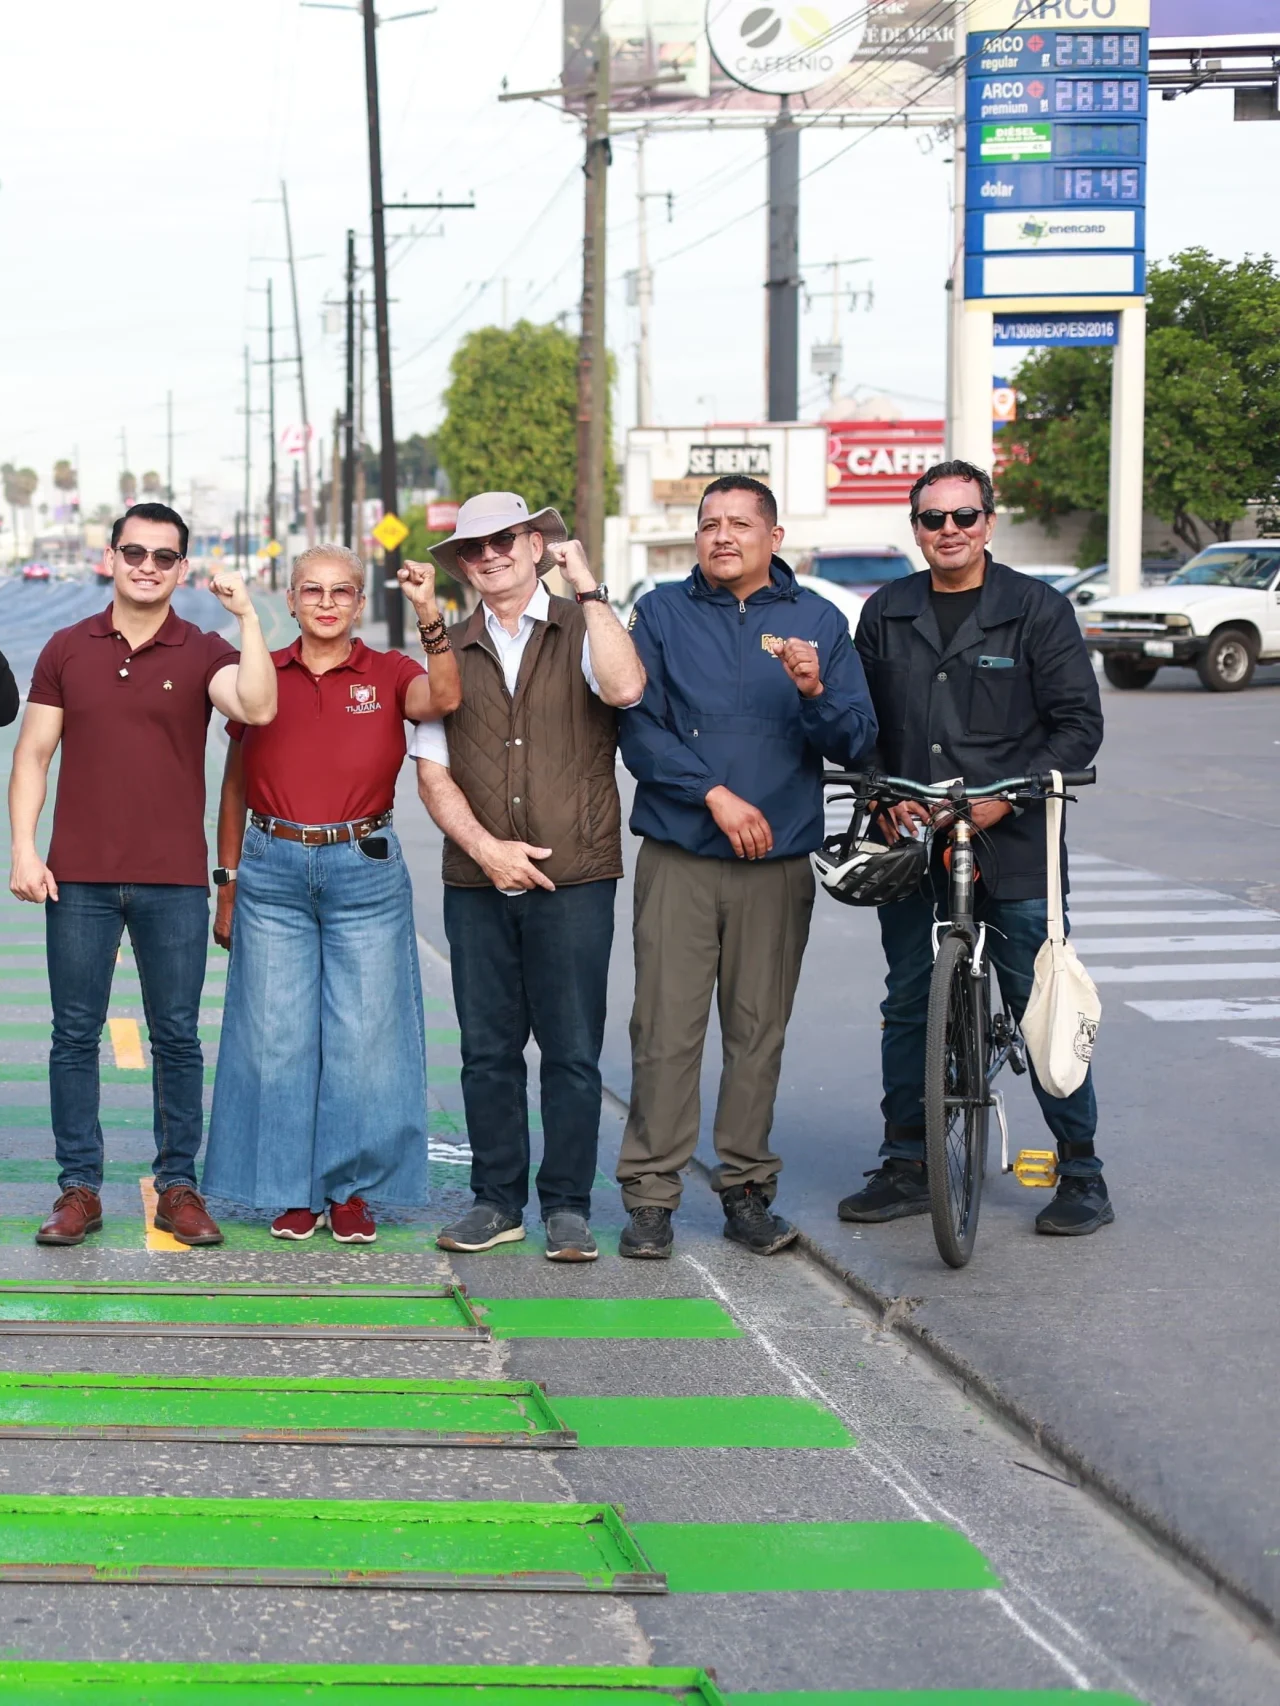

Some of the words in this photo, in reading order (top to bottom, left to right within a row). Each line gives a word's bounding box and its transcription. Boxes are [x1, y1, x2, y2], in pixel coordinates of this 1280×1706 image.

[1012, 0, 1116, 19] ARCO
[982, 36, 1023, 53] ARCO
[1056, 35, 1140, 66] 23.99
[736, 56, 833, 73] CAFFENIO
[981, 56, 1019, 72] regular
[982, 82, 1023, 99] ARCO
[1056, 81, 1139, 111] 28.99
[981, 101, 1028, 118] premium
[981, 181, 1014, 197] dolar
[1064, 169, 1138, 199] 16.45
[691, 448, 714, 474] SE
[345, 702, 382, 712] TIJUANA
